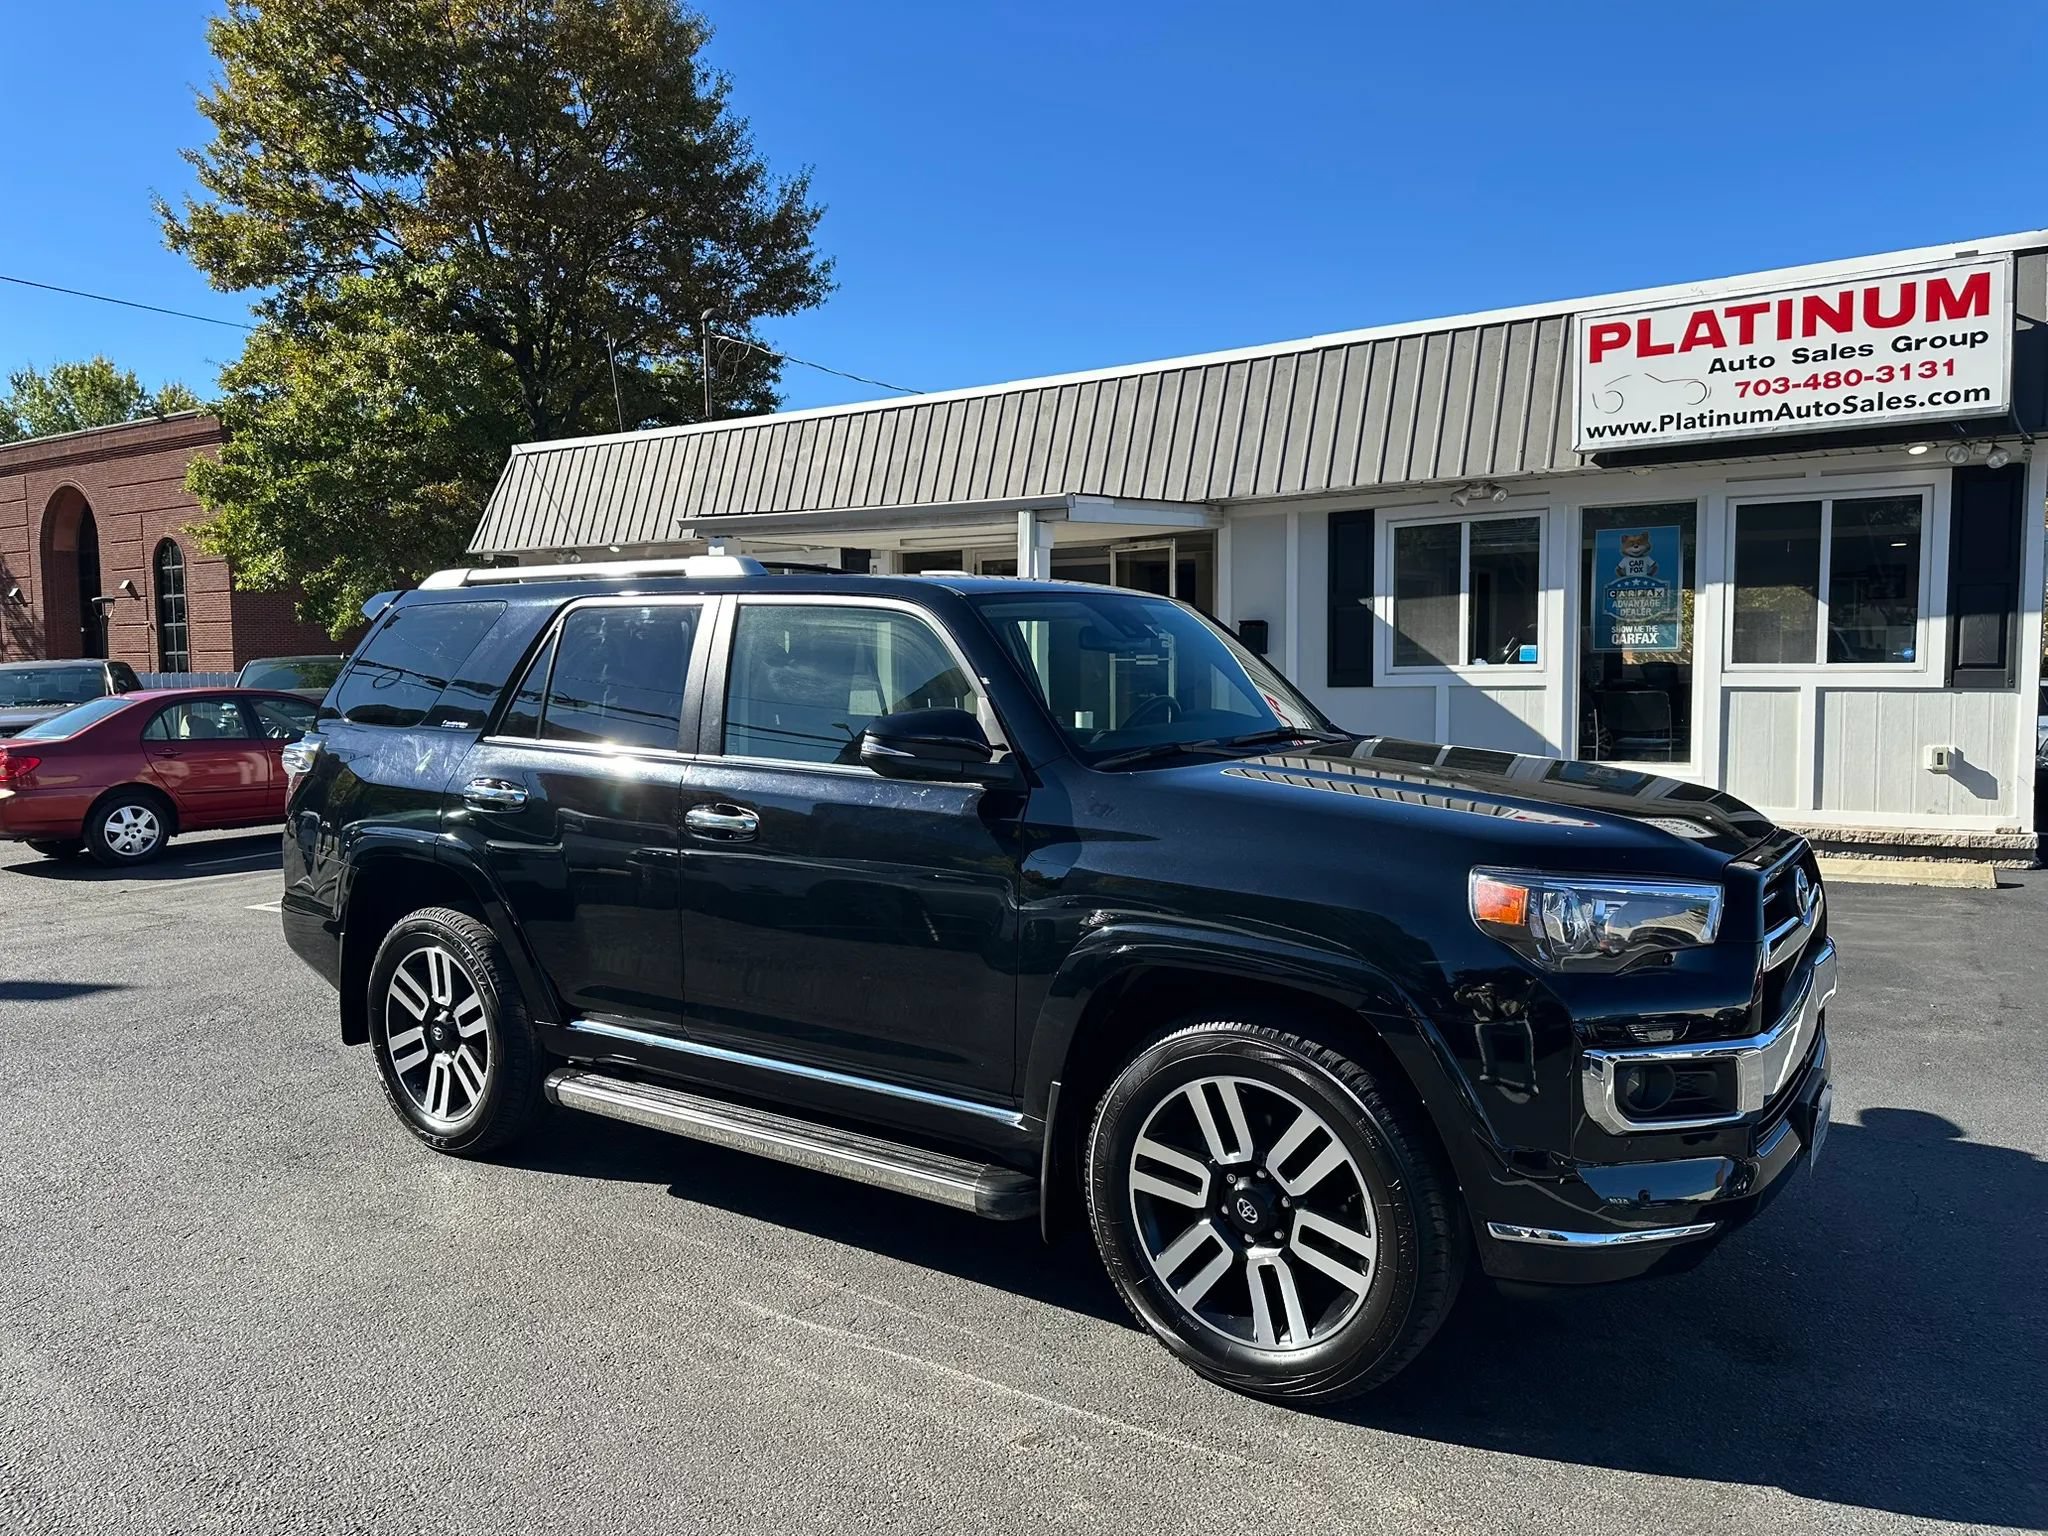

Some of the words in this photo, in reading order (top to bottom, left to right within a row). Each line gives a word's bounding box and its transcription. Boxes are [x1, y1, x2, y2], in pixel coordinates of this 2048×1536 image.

[1589, 272, 1991, 364] PLATINUM
[1708, 352, 1776, 375] Auto
[1791, 343, 1874, 365] Sales
[1891, 328, 1989, 353] Group
[1734, 358, 1955, 399] 703-480-3131
[1586, 386, 1990, 439] www.PlatinumAutoSales.com
[1609, 589, 1664, 598] CARFAX
[1612, 600, 1661, 608] ADVANTAGE
[1620, 608, 1652, 616] DEALER
[1611, 625, 1633, 633] SHOW
[1634, 625, 1645, 633] ME
[1646, 624, 1658, 632] THE
[1611, 633, 1659, 645] CARFAX
